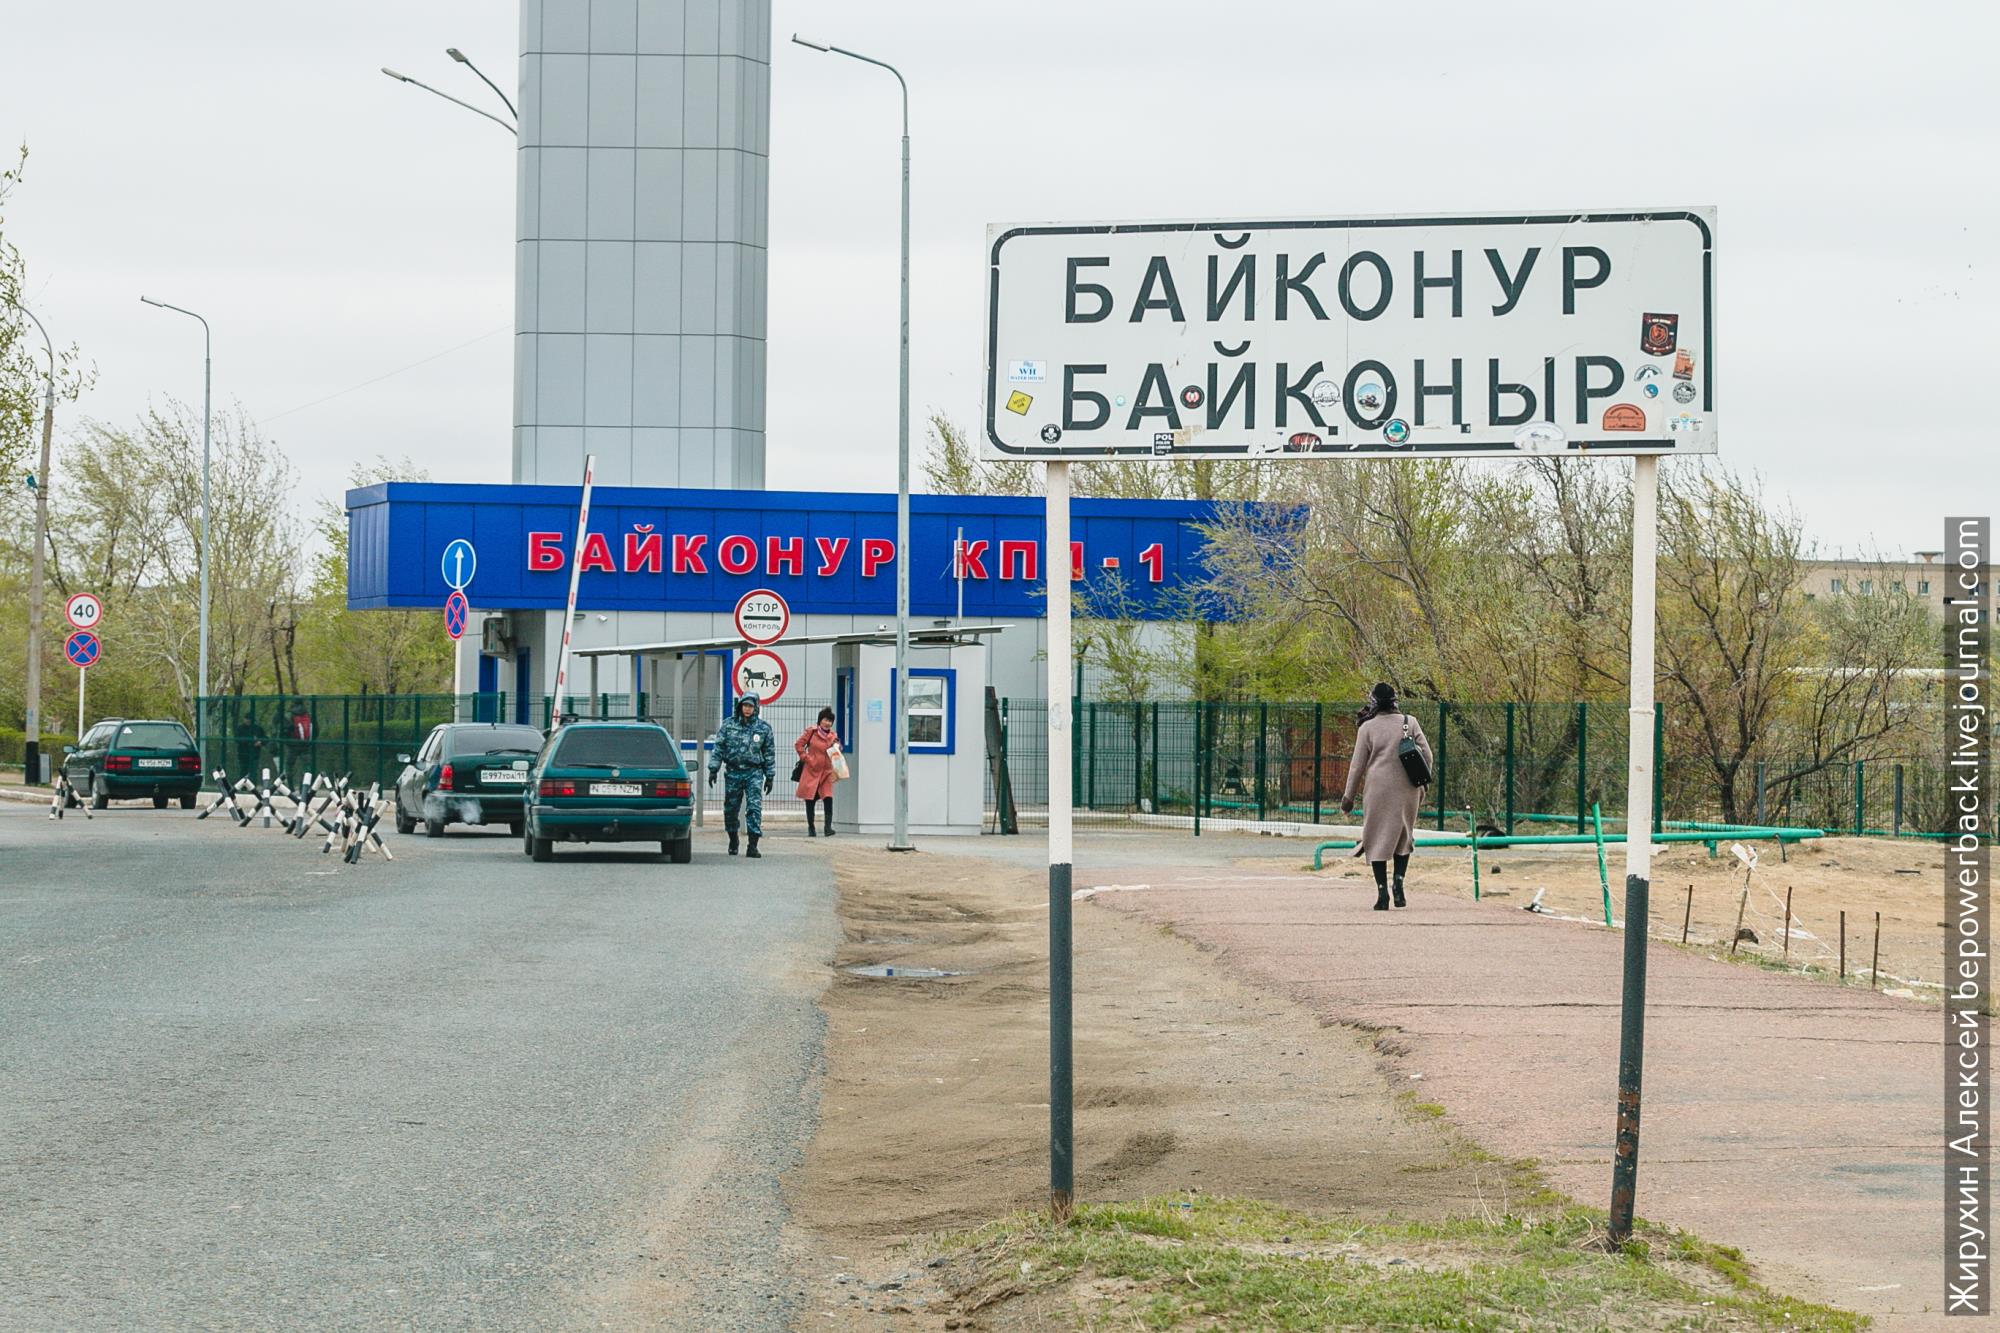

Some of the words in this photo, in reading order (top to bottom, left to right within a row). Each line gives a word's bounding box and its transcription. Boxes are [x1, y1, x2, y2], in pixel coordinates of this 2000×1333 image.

[1065, 232, 1612, 324] БАЙКОНУР
[527, 523, 896, 578] БАЙКОНУР
[73, 604, 95, 619] 40
[747, 602, 779, 613] STOP
[743, 623, 781, 631] КОНТРОЛЬ
[488, 771, 502, 779] 997
